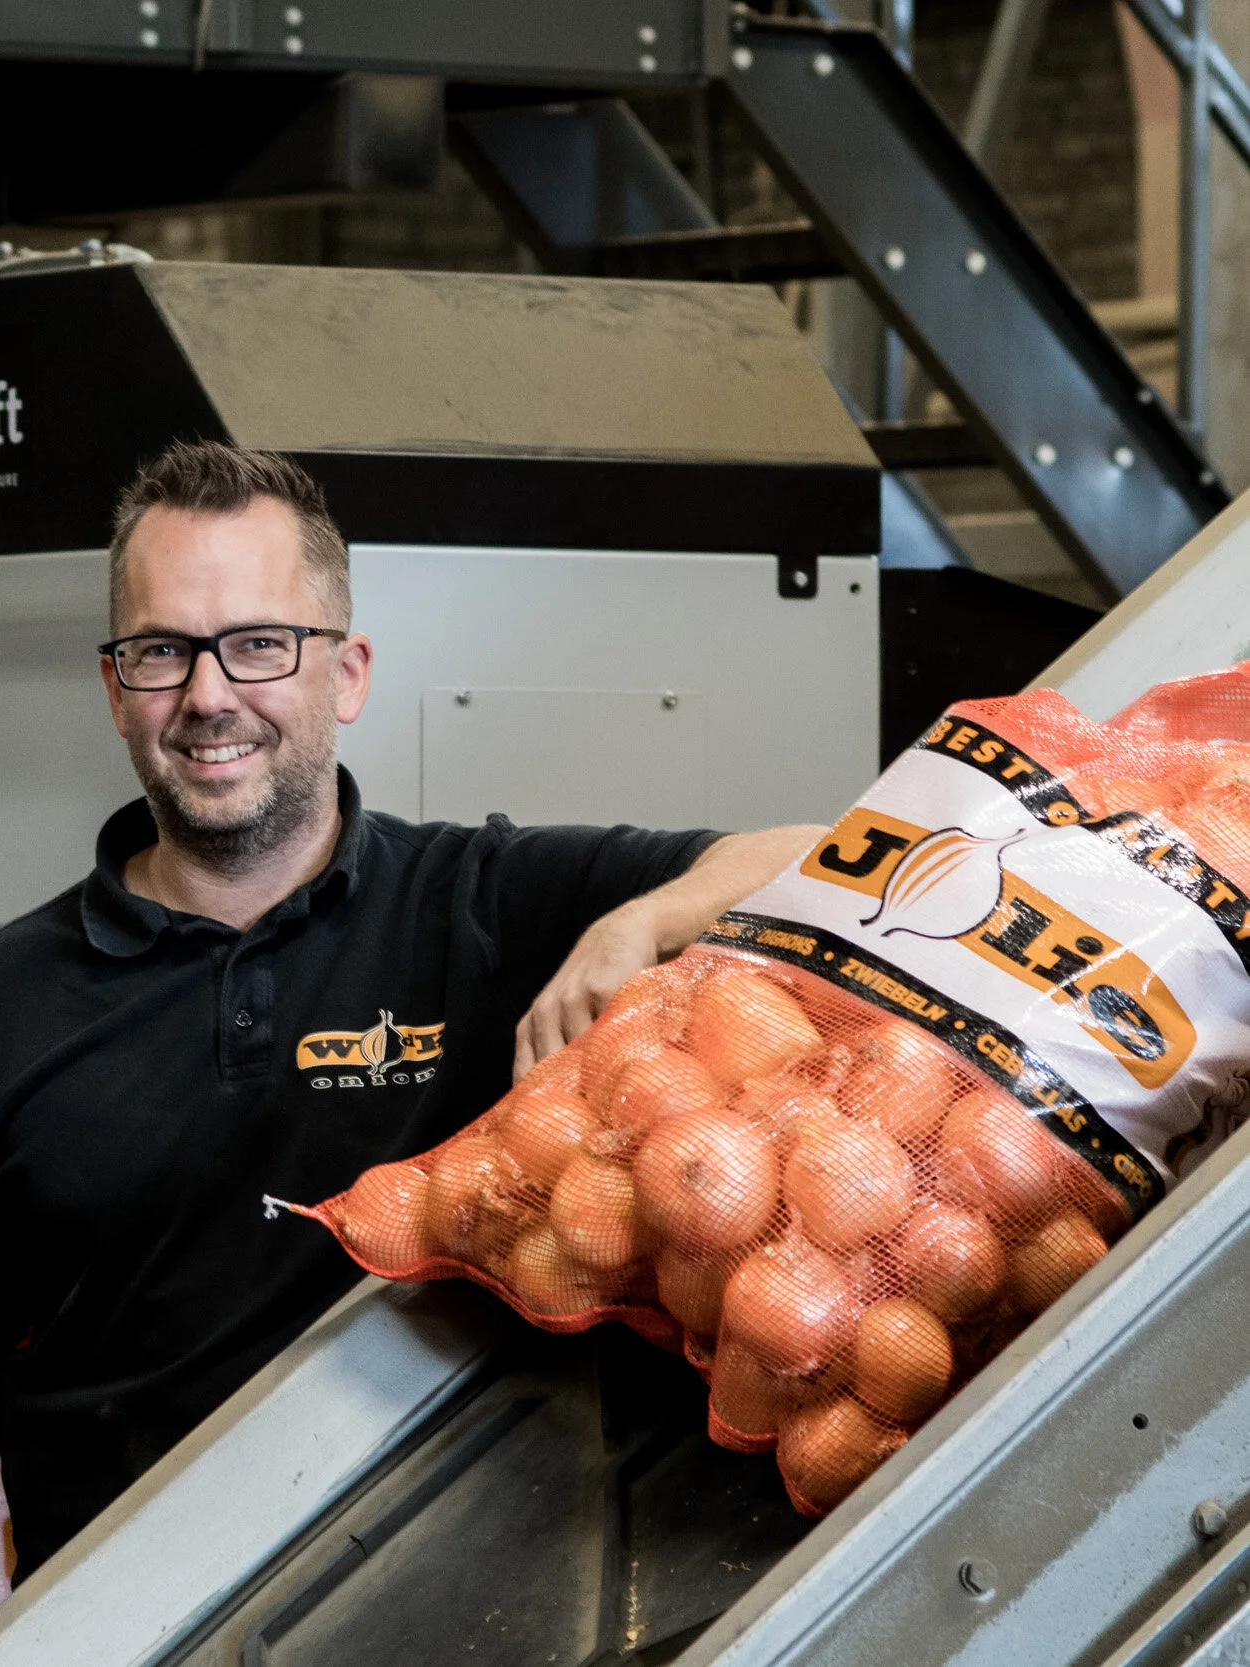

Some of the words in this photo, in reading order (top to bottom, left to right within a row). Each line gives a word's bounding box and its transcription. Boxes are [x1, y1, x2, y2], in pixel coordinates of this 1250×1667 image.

[927, 720, 1035, 780] BEST
[839, 957, 948, 1021] ZWIEBELN
[976, 1033, 1088, 1133] CEBLLAS
